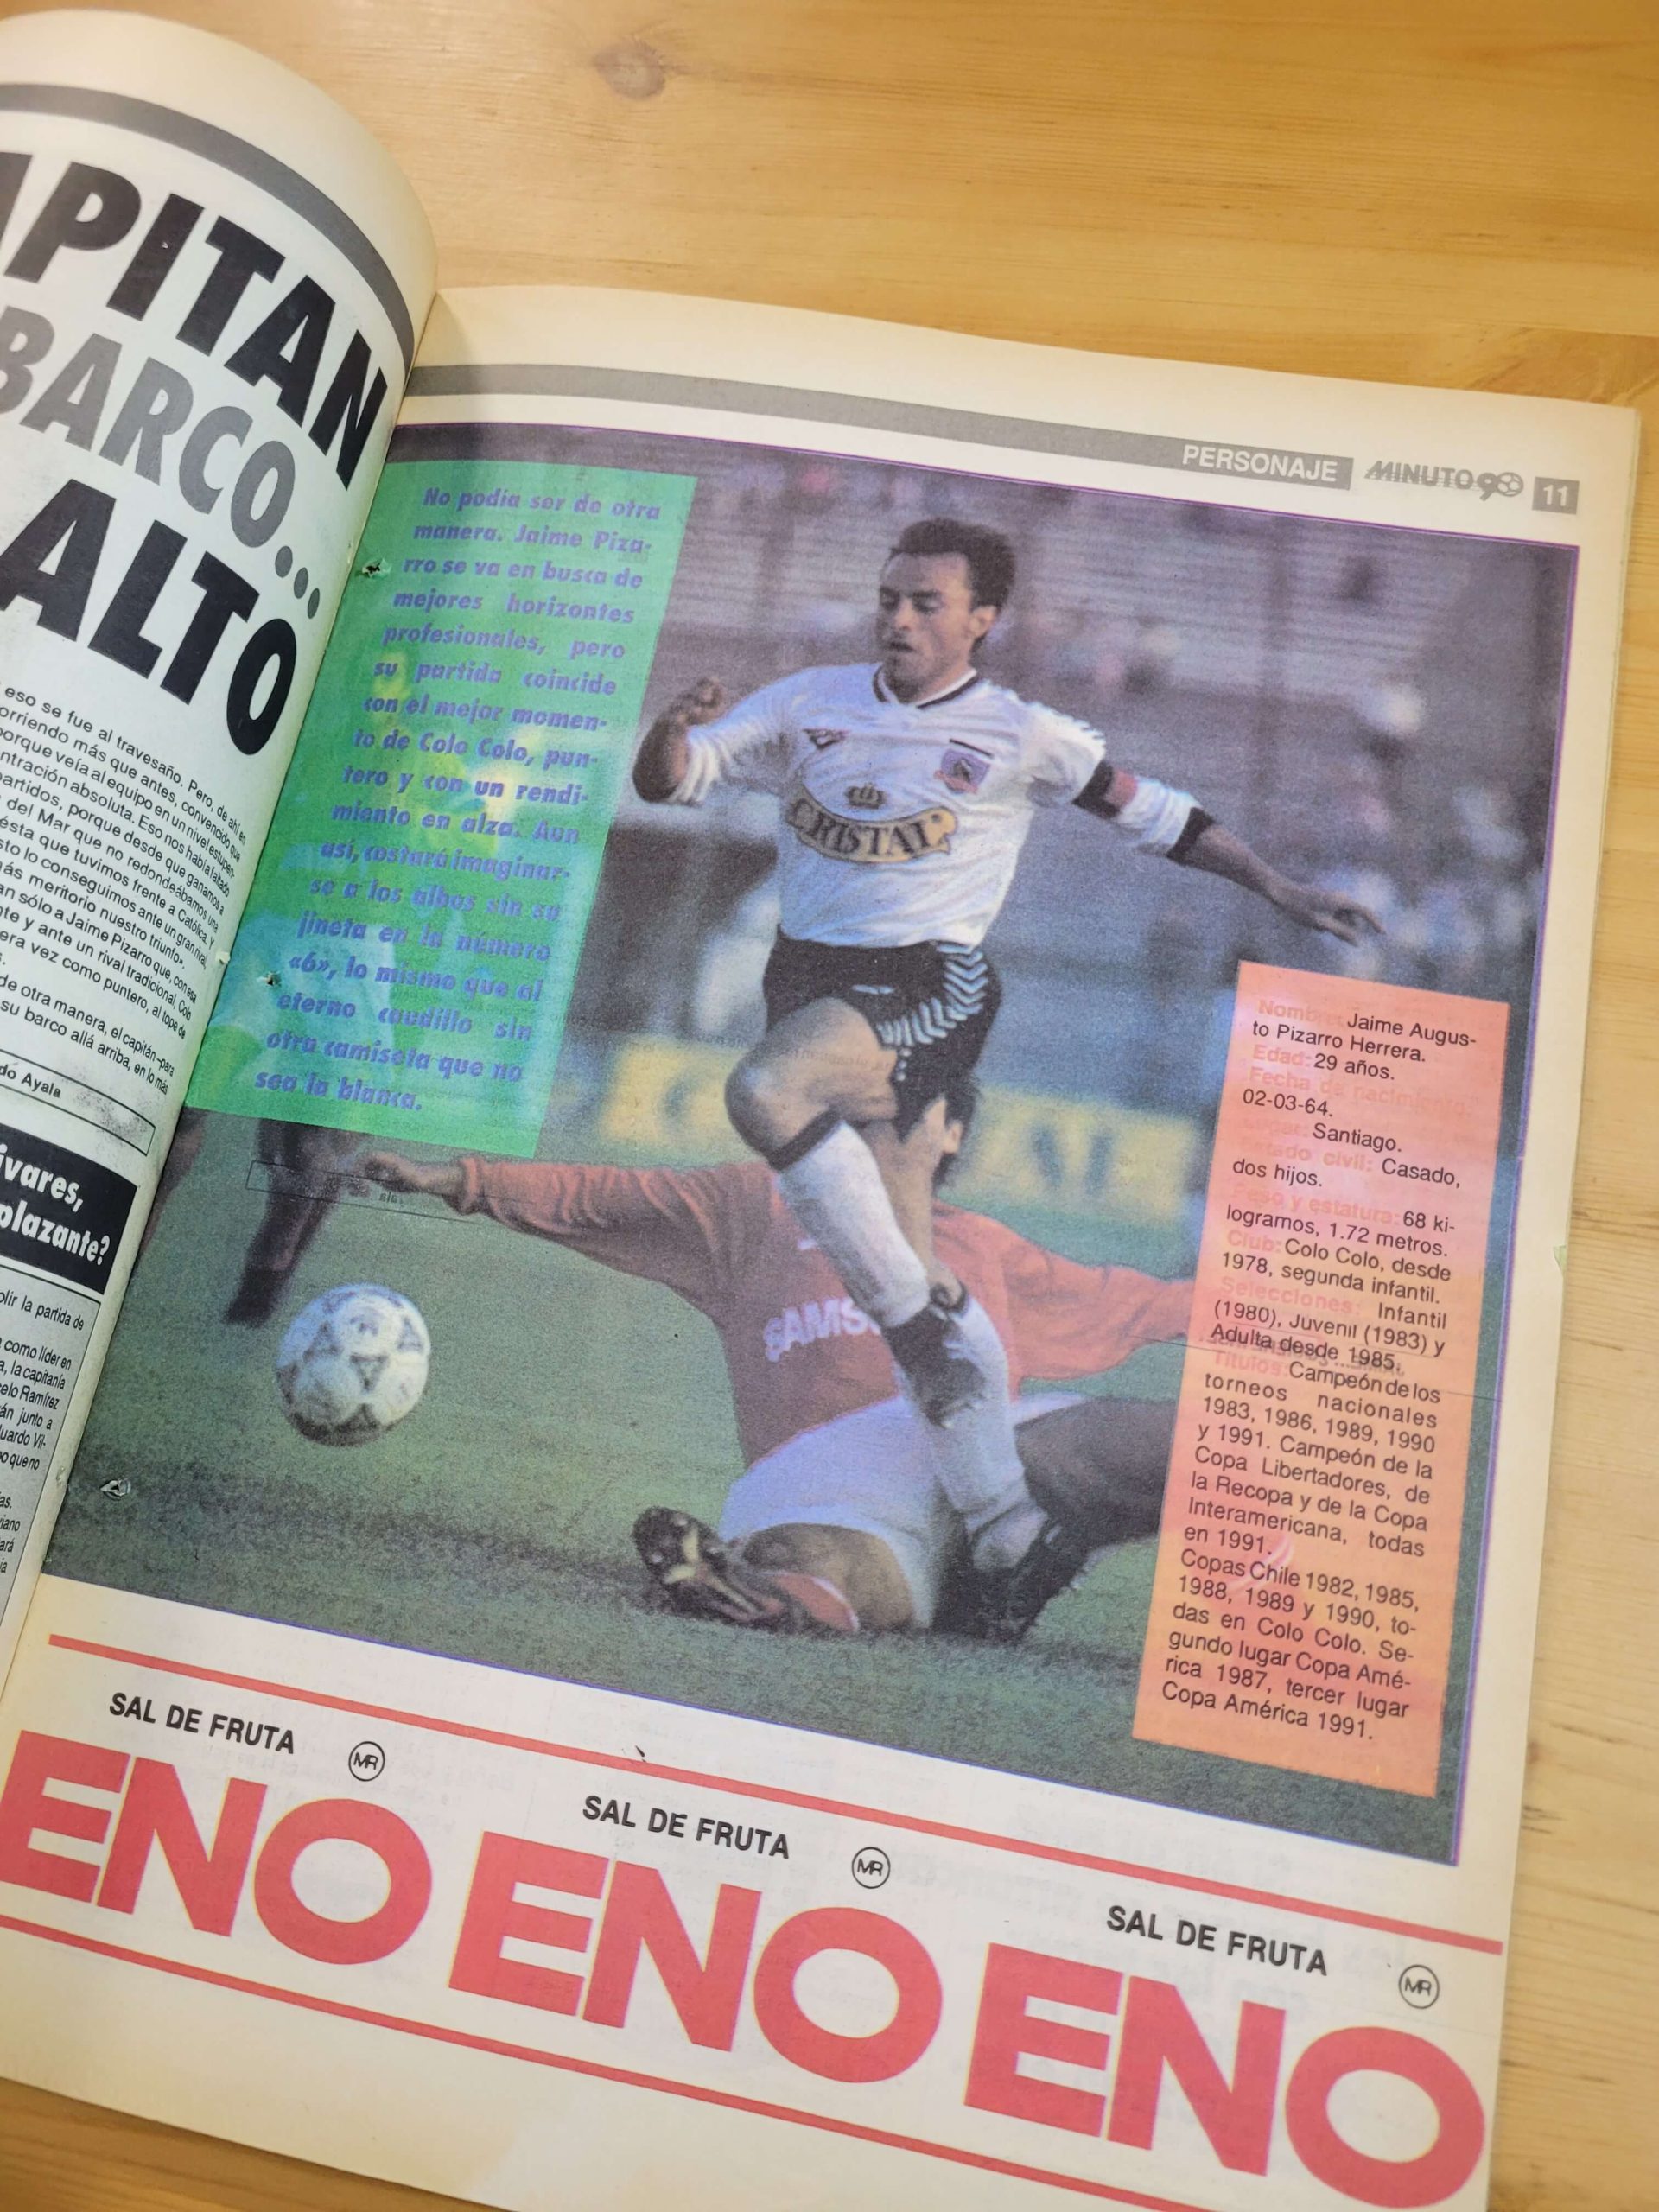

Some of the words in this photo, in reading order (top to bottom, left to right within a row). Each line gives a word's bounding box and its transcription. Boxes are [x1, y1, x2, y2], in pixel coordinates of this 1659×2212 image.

[1182, 444, 1338, 482] PERSONAJE
[423, 487, 450, 505] No
[530, 496, 564, 510] ser
[573, 493, 601, 513] de
[611, 500, 660, 519] otra
[1543, 484, 1567, 508] 11
[413, 524, 501, 541] manera.
[513, 524, 582, 546] Jaime
[593, 530, 652, 554] Piza-
[0, 479, 296, 755] ALTO
[392, 588, 482, 613] mejores
[505, 593, 632, 623] horizontes
[381, 621, 545, 655] profesionales,
[569, 639, 626, 659] pero
[361, 696, 398, 712] con
[404, 693, 429, 714] el
[433, 699, 503, 724] mejor
[511, 708, 606, 730] momen-
[5, 688, 36, 706] eso
[42, 702, 61, 717] se
[68, 710, 92, 732] fue
[99, 728, 112, 743] al
[116, 735, 183, 786] travesaño.
[188, 779, 213, 811] Pero,
[217, 805, 227, 823] de
[353, 728, 375, 747] to
[382, 728, 410, 750] de
[419, 731, 467, 755] Colo
[476, 737, 533, 765] Colo,
[543, 749, 597, 770] pun-
[74, 738, 106, 763] más
[111, 758, 137, 779] que
[140, 777, 177, 807] antes,
[181, 802, 231, 849] convencido
[331, 799, 410, 826] miento
[420, 811, 451, 830] en
[460, 811, 521, 837] alza.
[66, 912, 108, 943] Jaime
[111, 935, 153, 973] Pizarro
[21, 982, 51, 1007] otra
[54, 999, 108, 1038] manera,
[61, 959, 102, 983] como
[103, 977, 149, 1014] puntero,
[24, 1006, 67, 1035] barco
[70, 1029, 94, 1049] allá
[98, 1044, 131, 1072] arriba,
[1252, 1020, 1269, 1037] to
[1276, 1022, 1343, 1049] Pizarro
[1349, 1034, 1425, 1062] Herrera.
[1346, 1012, 1403, 1035] Jaime
[1408, 1021, 1476, 1046] Augus-
[21, 1073, 61, 1098] Ayala
[1313, 1052, 1338, 1071] 29
[1344, 1058, 1395, 1080] años.
[1242, 1087, 1332, 1117] 02-03-64.
[1312, 1122, 1402, 1153] Santiago.
[1232, 1157, 1267, 1178] dos
[1273, 1163, 1322, 1187] hijos.
[1381, 1156, 1460, 1188] Casado,
[1225, 1203, 1319, 1236] logramos,
[1329, 1222, 1370, 1243] 1.72
[1376, 1232, 1447, 1256] metros.
[1402, 1210, 1427, 1229] 68
[1433, 1214, 1454, 1233] ki-
[1223, 1251, 1273, 1277] 1978,
[1281, 1264, 1363, 1292] segunda
[1370, 1276, 1440, 1304] infantil.
[1284, 1237, 1329, 1261] Colo
[1335, 1246, 1384, 1272] Colo,
[1391, 1256, 1451, 1281] desde
[21, 1295, 32, 1312] la
[35, 1306, 70, 1325] partida
[73, 1316, 84, 1331] de
[1214, 1299, 1281, 1329] (1980),
[1288, 1313, 1357, 1338] Juvenil
[1363, 1324, 1427, 1355] (1983)
[1433, 1340, 1445, 1358] y
[1377, 1301, 1446, 1329] Infantil
[4, 1342, 37, 1359] como
[38, 1348, 60, 1367] líder
[60, 1357, 72, 1370] en
[1210, 1322, 1275, 1351] Adulta
[1278, 1335, 1338, 1361] desde
[1348, 1346, 1400, 1372] 1985.
[1204, 1395, 1255, 1423] 1983,
[1264, 1406, 1317, 1434] 1986,
[1325, 1417, 1378, 1446] 1989,
[1387, 1428, 1435, 1453] 1990
[1205, 1372, 1287, 1401] torneos
[1317, 1394, 1437, 1428] nacionales
[1194, 1445, 1247, 1471] Copa
[1261, 1456, 1390, 1500] Libertadores,
[1404, 1484, 1430, 1504] de
[1184, 1525, 1208, 1542] en
[1217, 1528, 1272, 1555] 1991.
[1188, 1496, 1346, 1545] Interamericana,
[1368, 1530, 1424, 1557] todas
[1180, 1548, 1246, 1576] Copas
[1249, 1560, 1300, 1587] Chile
[1306, 1571, 1358, 1601] 1982,
[1365, 1582, 1419, 1612] 1985,
[1172, 1601, 1210, 1624] das
[1220, 1612, 1245, 1631] en
[1256, 1616, 1304, 1642] Colo
[1313, 1627, 1365, 1655] Colo.
[1378, 1639, 1414, 1662] Se-
[1168, 1630, 1233, 1656] gundo
[1238, 1639, 1292, 1668] lugar
[1295, 1650, 1350, 1680] Copa
[1355, 1663, 1410, 1689] Amé-
[109, 1692, 157, 1723] SAL
[169, 1705, 203, 1732] DE
[210, 1714, 296, 1755] FRUTA
[1161, 1680, 1217, 1709] Copa
[1223, 1693, 1308, 1727] América
[1318, 1711, 1372, 1739] 1991.
[0, 1729, 433, 1966] ENO
[582, 1795, 636, 1827] SAL
[649, 1808, 686, 1839] DE
[695, 1818, 791, 1859] FRUTA
[448, 1830, 943, 2083] ENO
[1106, 1906, 1164, 1942] SAL
[1175, 1921, 1217, 1952] DE
[1227, 1932, 1327, 1976] FRUTA
[963, 1943, 1485, 2209] ENO
